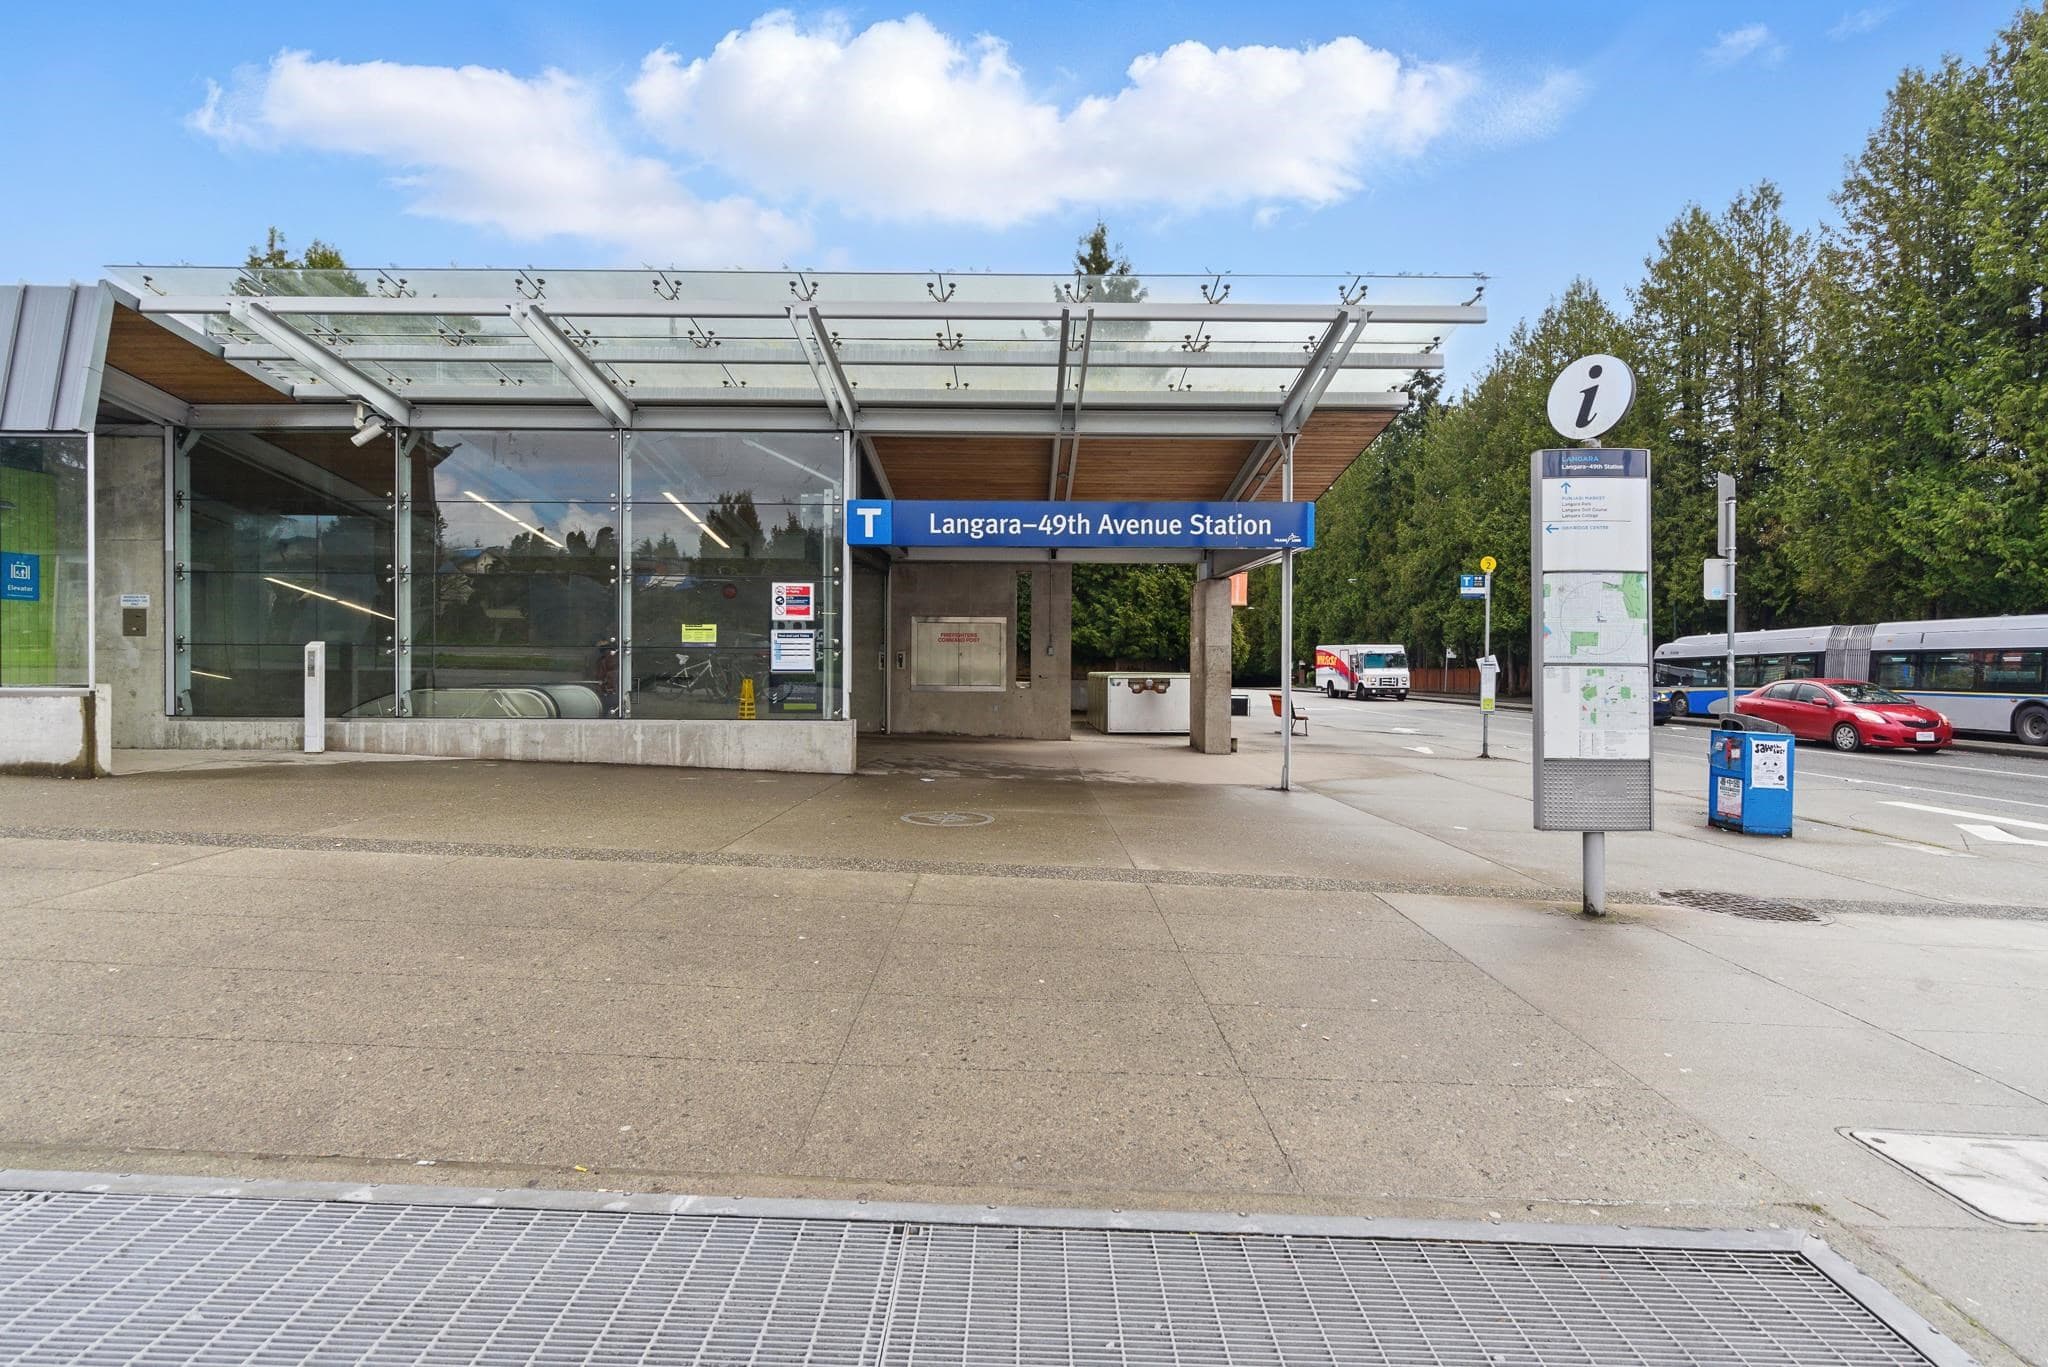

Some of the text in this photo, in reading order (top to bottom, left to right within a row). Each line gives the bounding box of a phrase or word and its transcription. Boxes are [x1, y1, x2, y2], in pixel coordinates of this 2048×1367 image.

[856, 507, 882, 538] T
[1097, 513, 1183, 536] Avenue
[1189, 513, 1272, 536] Station
[7, 584, 33, 592] Elevator
[1463, 576, 1471, 586] T
